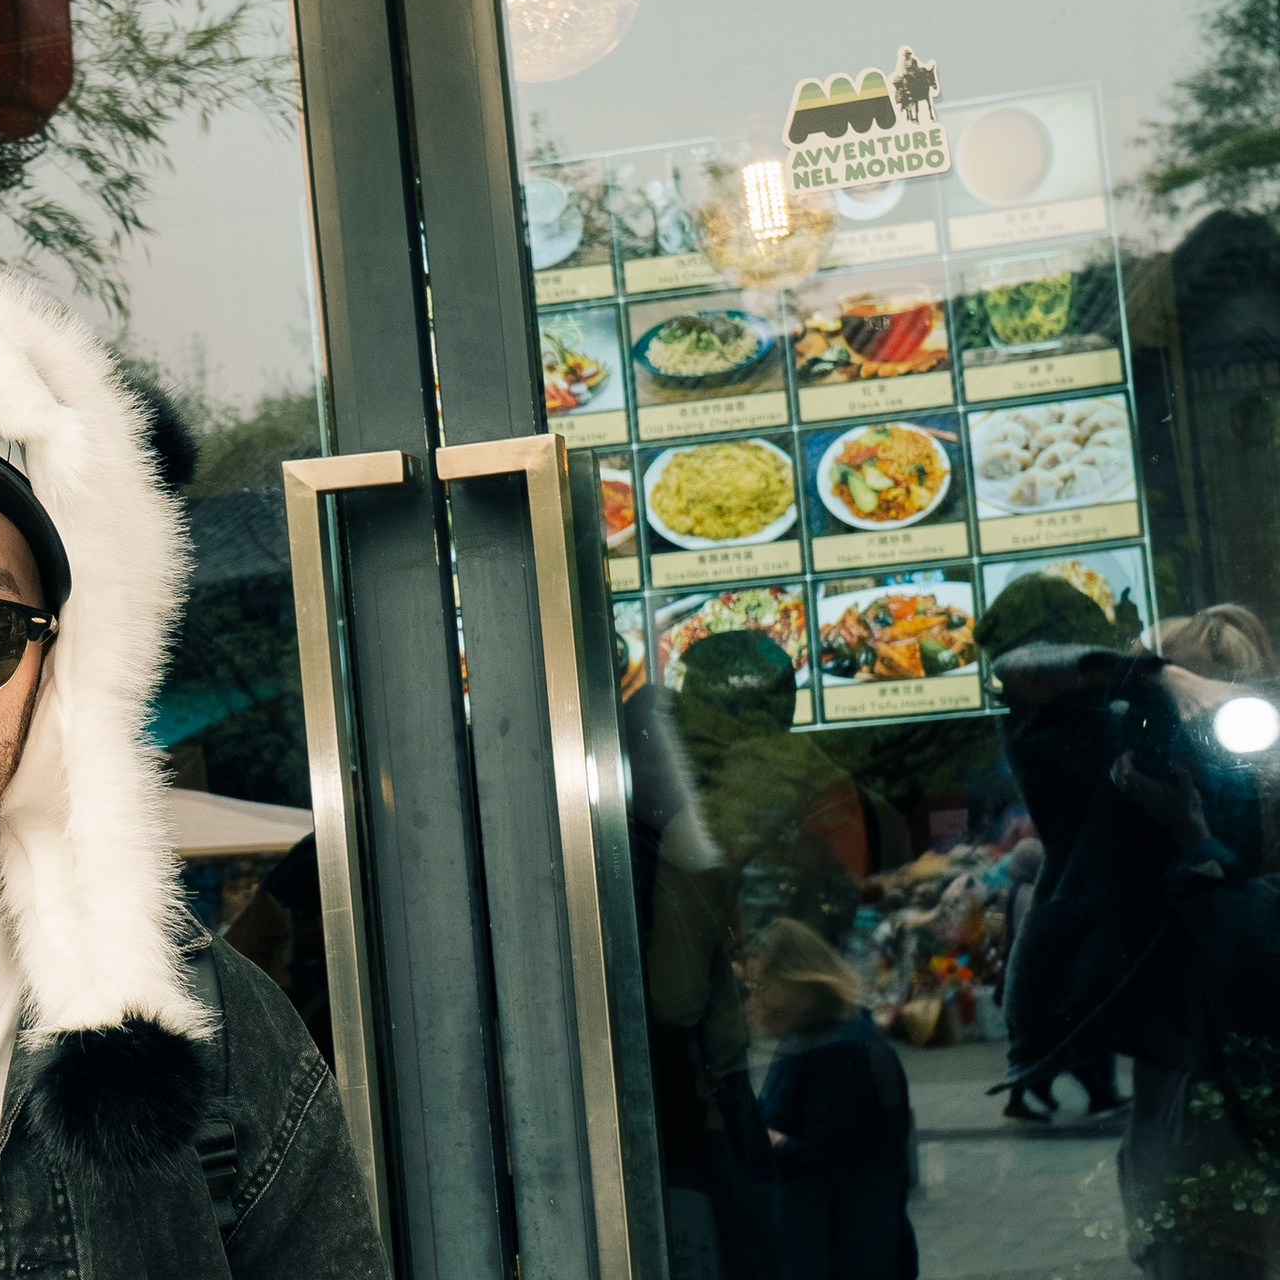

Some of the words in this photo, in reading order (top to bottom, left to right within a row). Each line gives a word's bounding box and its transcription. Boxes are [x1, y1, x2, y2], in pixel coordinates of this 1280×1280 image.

[791, 127, 944, 170] AVVENTURE
[792, 166, 839, 190] NEL
[844, 148, 946, 183] MONDO
[712, 566, 733, 578] and
[736, 564, 759, 578] Egg
